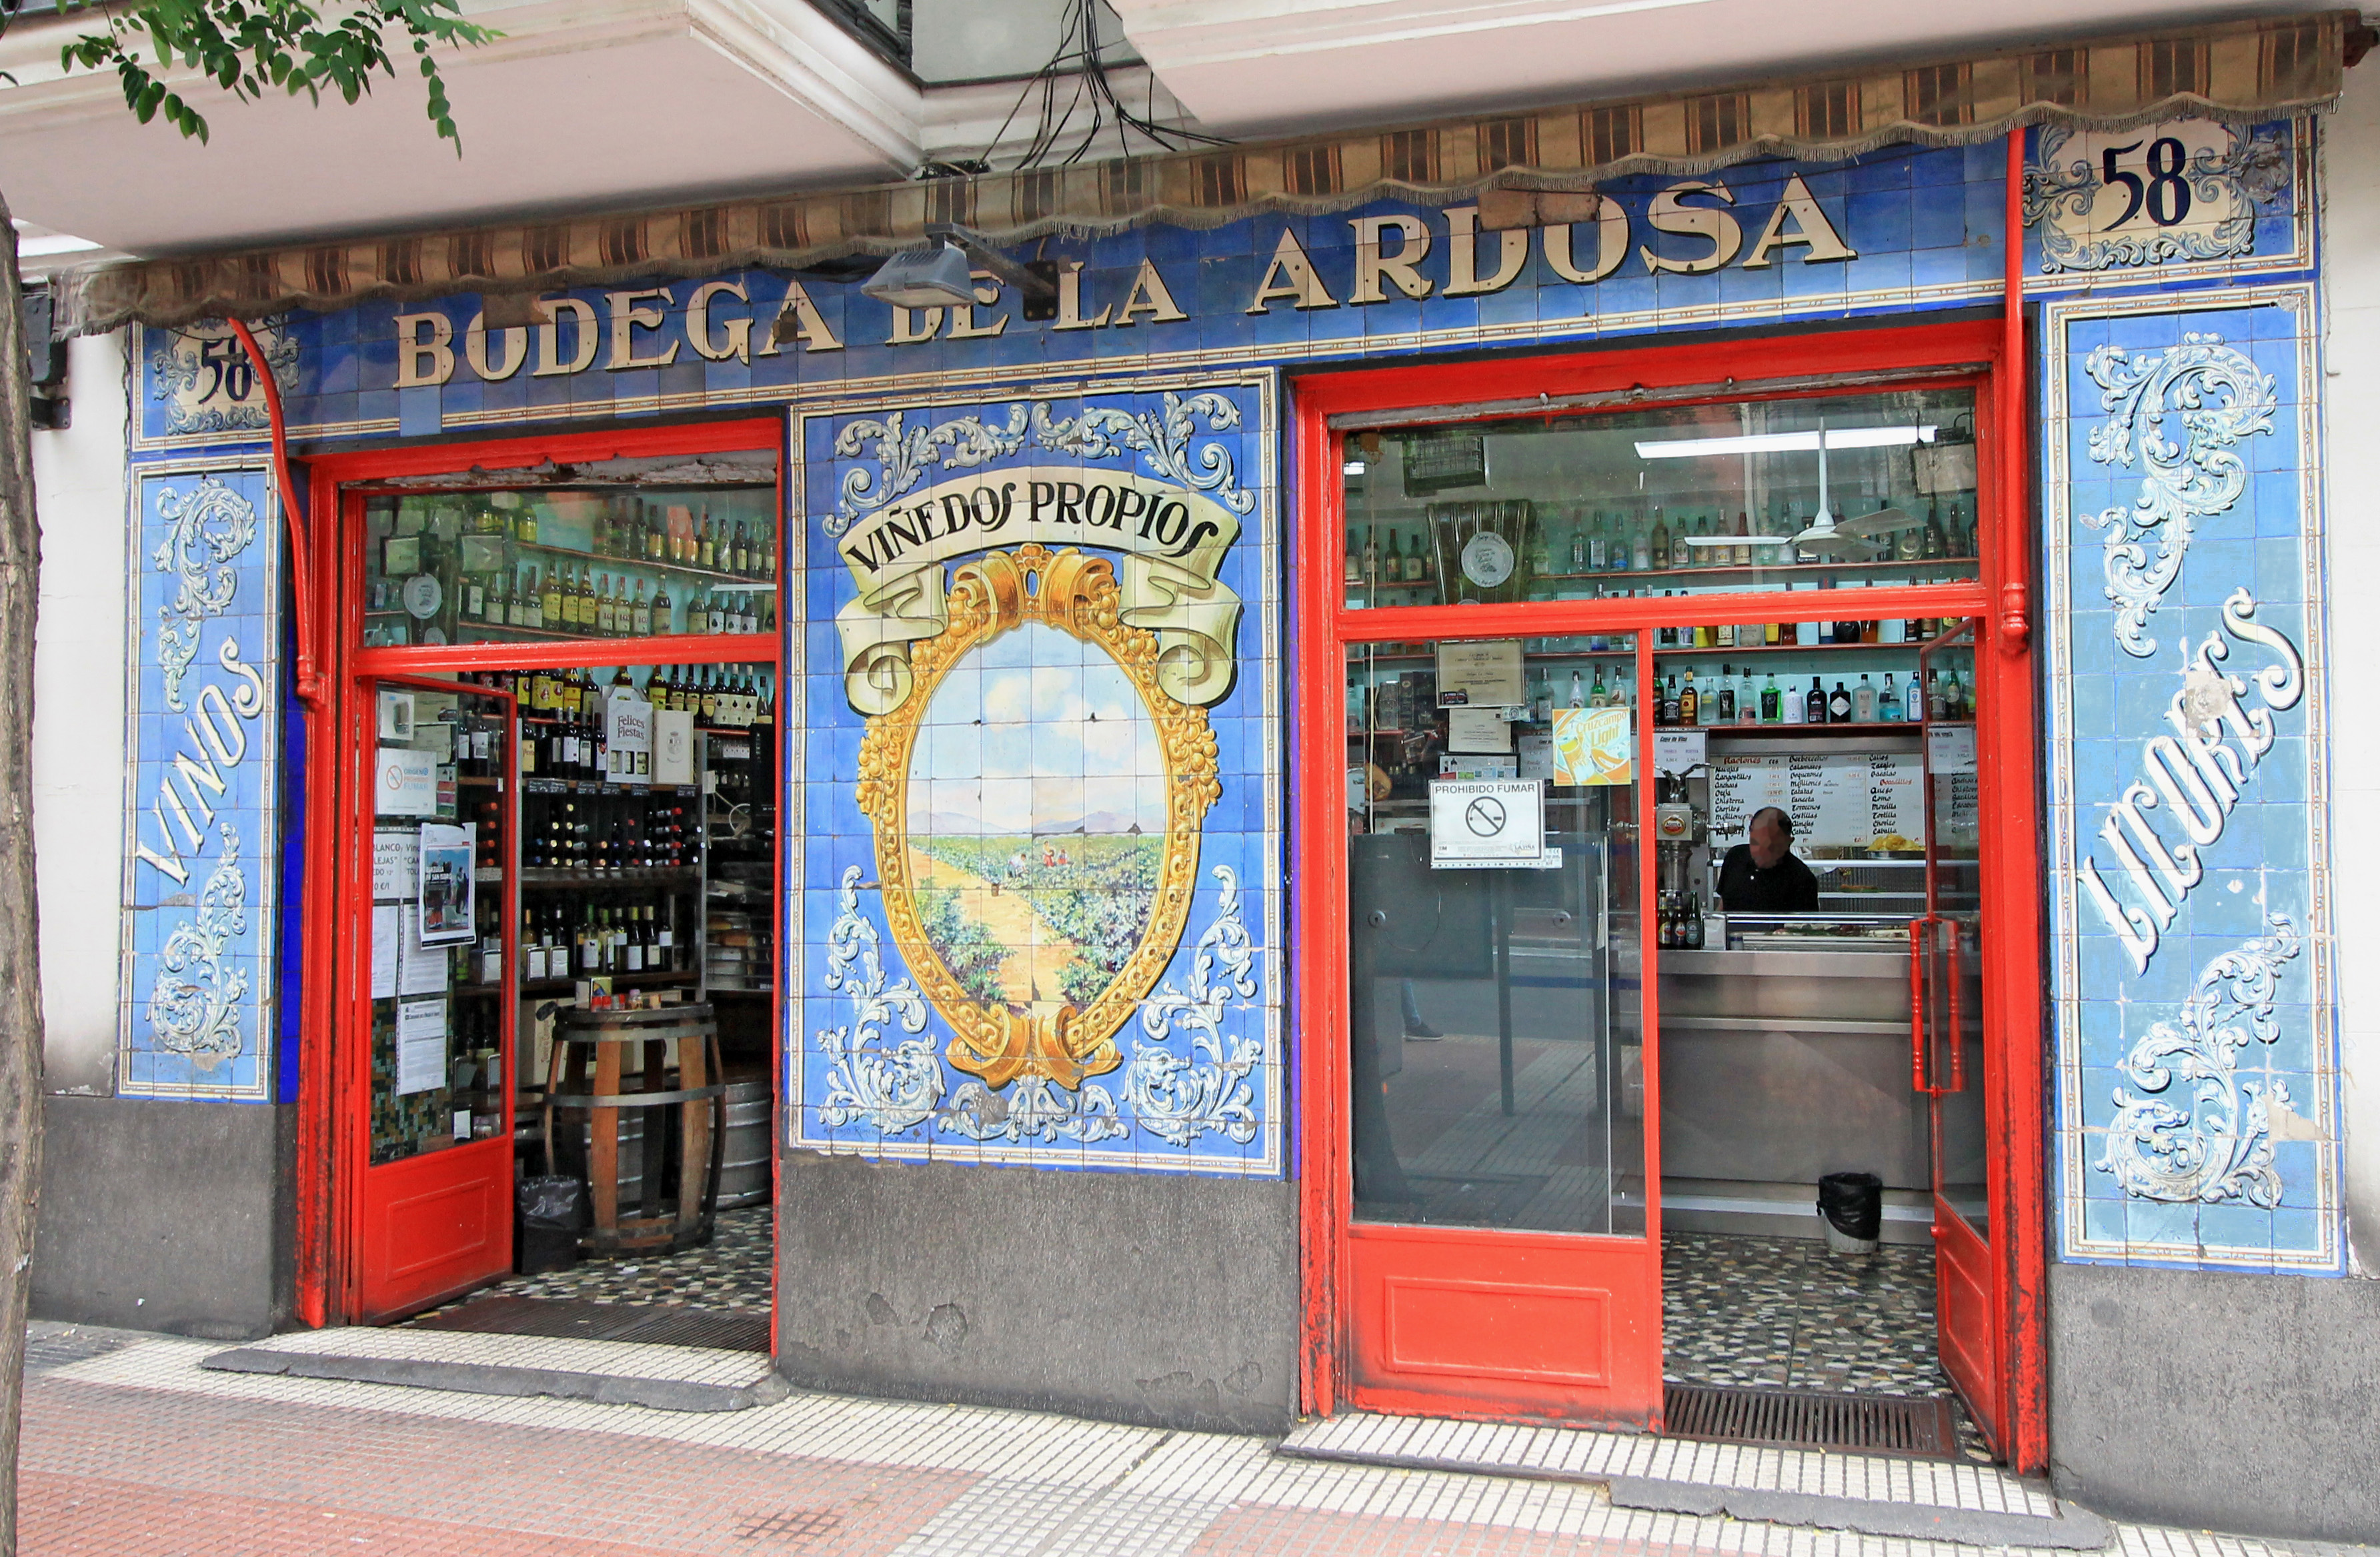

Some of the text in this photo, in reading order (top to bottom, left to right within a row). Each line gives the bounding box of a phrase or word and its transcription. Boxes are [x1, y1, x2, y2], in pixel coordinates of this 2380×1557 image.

[2102, 137, 2191, 231] 58
[393, 281, 844, 389] BODEGA
[1052, 257, 1189, 329] LA
[1246, 173, 1859, 315] ARDOSA
[199, 333, 253, 404] 58
[846, 481, 1219, 573] VIÑEDOS PROPIOS
[618, 715, 645, 729] Felices
[1576, 712, 1626, 733] Cruzcampo
[618, 727, 645, 740] Fiestas
[1591, 724, 1620, 746] Light
[136, 635, 263, 888] VINOS
[1869, 753, 1889, 761] Callos
[1435, 784, 1535, 794] PROHIBIDO FUMAR
[2077, 587, 2303, 978] LICORES
[1873, 811, 1897, 820] Tortilla
